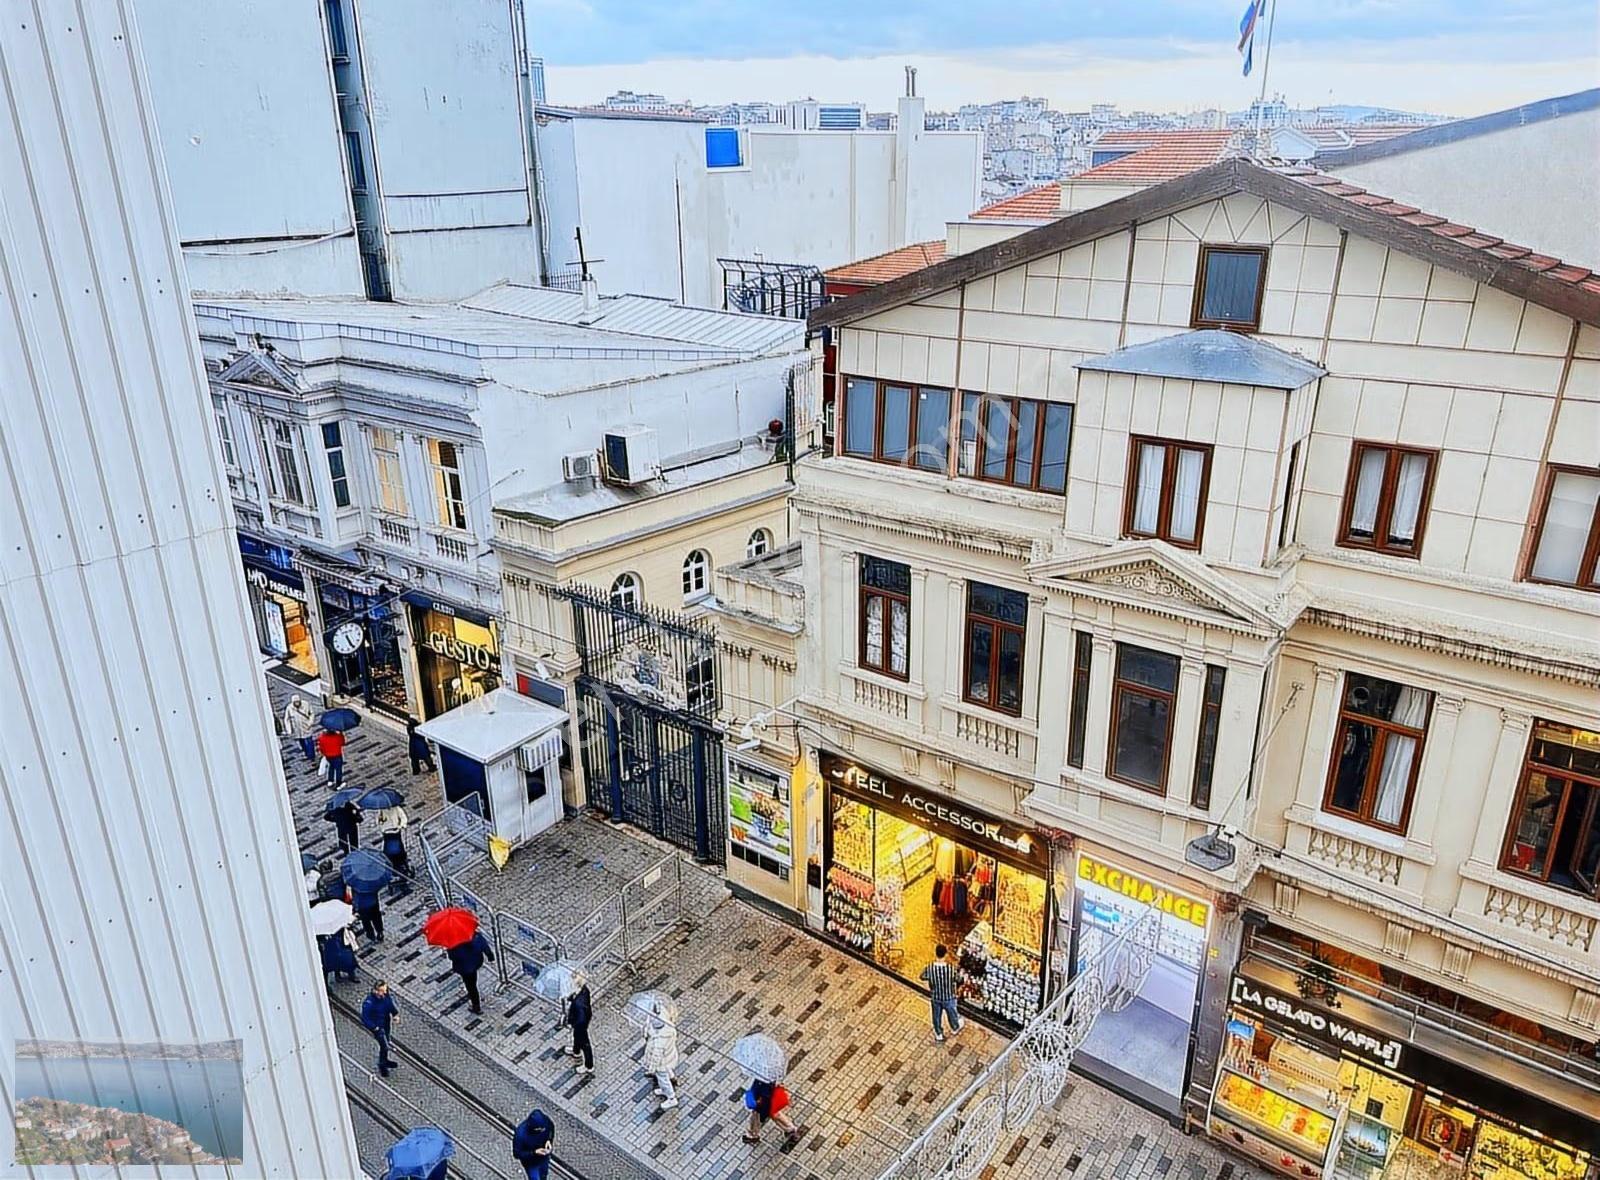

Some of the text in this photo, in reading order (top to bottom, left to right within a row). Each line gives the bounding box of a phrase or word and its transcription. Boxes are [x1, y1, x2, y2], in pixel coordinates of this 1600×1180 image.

[430, 631, 489, 670] GUSTO
[1079, 857, 1209, 927] EXCHANGE
[1264, 996, 1326, 1030] GELATO
